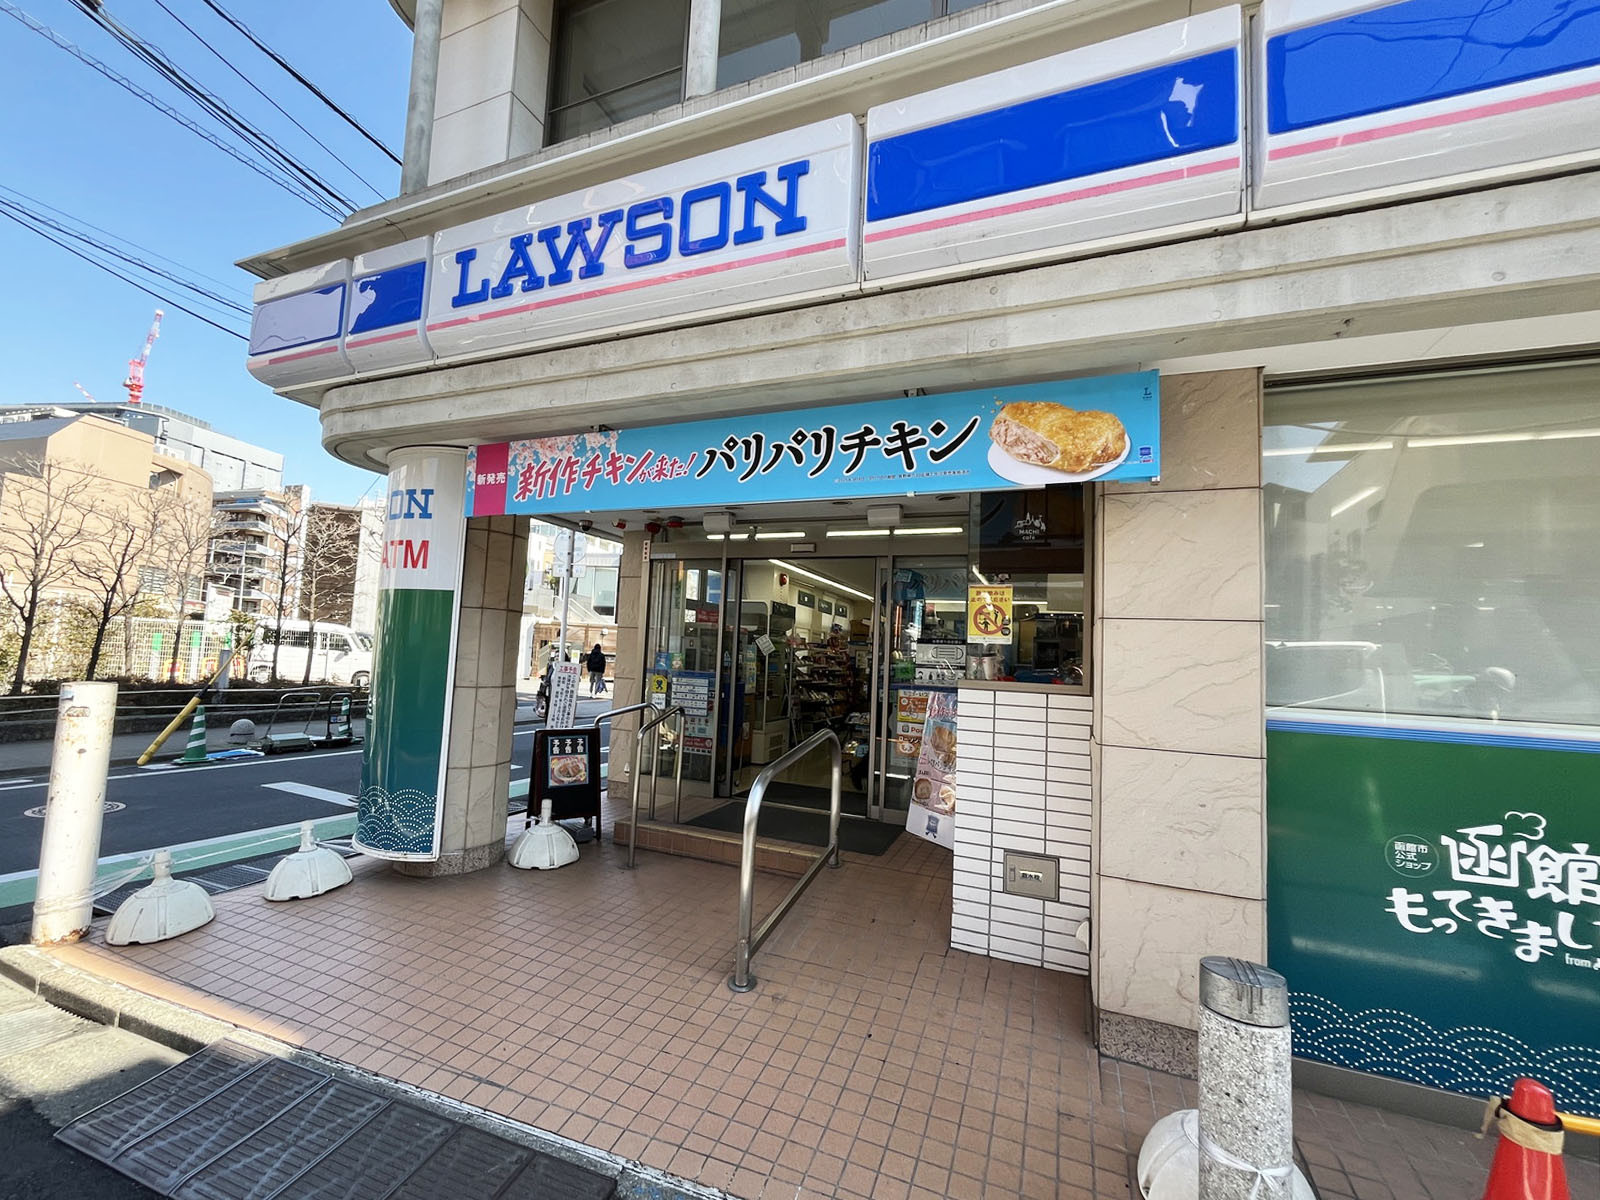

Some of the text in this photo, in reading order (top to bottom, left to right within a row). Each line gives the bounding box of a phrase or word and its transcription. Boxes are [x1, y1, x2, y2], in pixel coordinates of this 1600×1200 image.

[451, 159, 810, 309] LAWSON
[696, 416, 981, 482] パリパリチキン
[476, 472, 506, 486] 新発売
[382, 539, 430, 569] ATM
[1394, 841, 1429, 854] 函館市
[1395, 850, 1418, 862] 公式
[1395, 859, 1433, 871] ショップ
[1440, 824, 1600, 905] 函館
[1384, 887, 1600, 963] もってきまし
[1565, 952, 1592, 969] from
